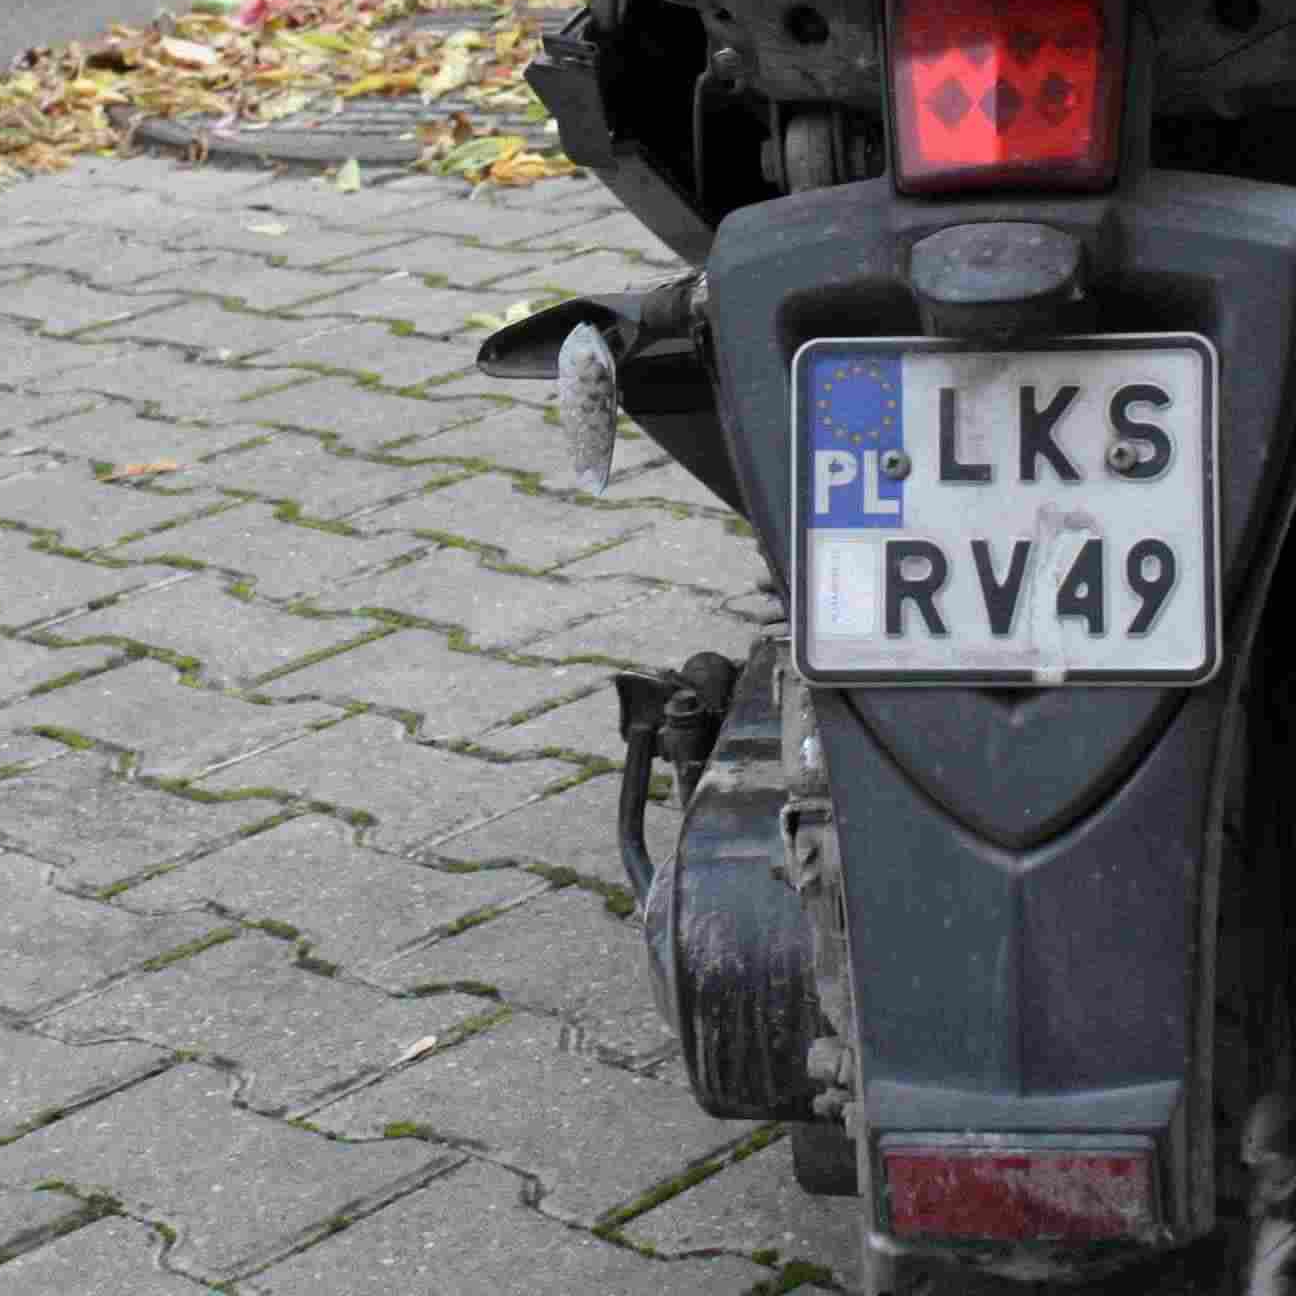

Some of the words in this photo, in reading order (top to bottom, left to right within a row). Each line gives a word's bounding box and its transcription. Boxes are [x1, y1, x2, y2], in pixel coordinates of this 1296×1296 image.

[814, 449, 900, 514] PL
[939, 384, 1173, 482] LKS
[885, 538, 1177, 636] RV49
